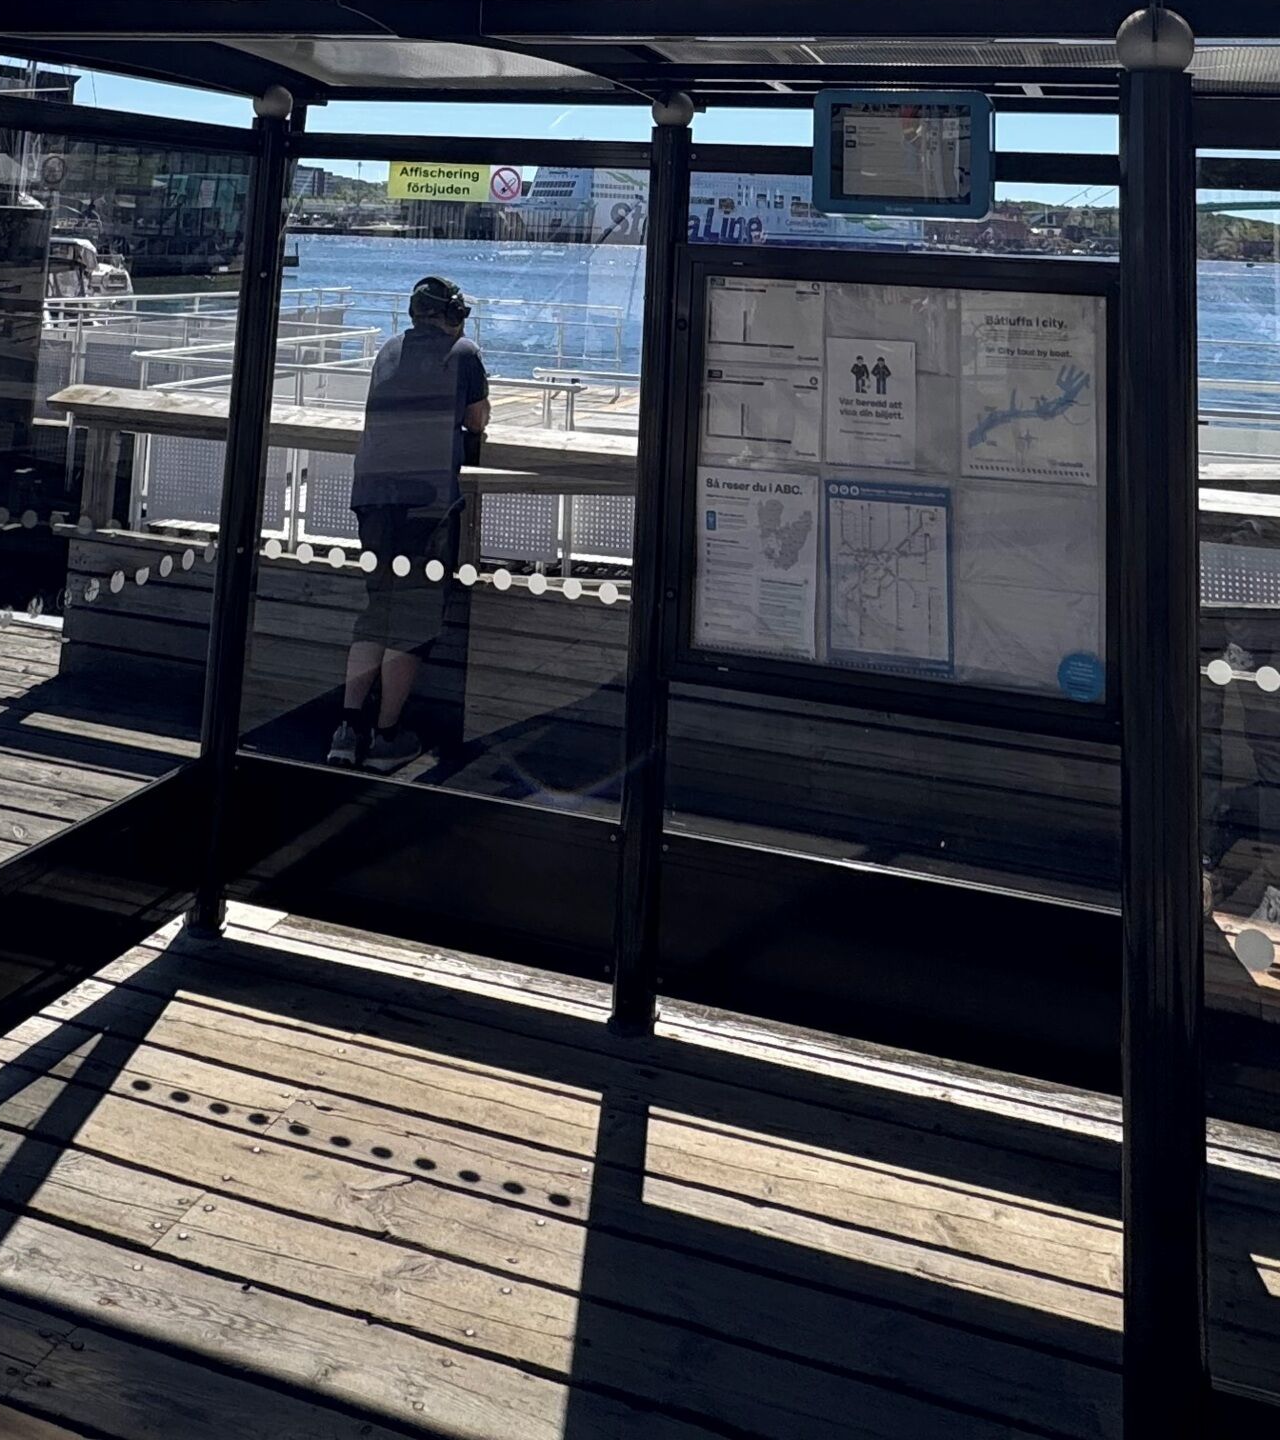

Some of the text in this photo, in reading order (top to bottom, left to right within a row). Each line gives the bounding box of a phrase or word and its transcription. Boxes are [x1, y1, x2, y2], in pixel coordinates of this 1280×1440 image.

[400, 166, 480, 182] Affischering
[407, 182, 470, 196] förbjuden
[1041, 317, 1068, 329] city.
[752, 482, 767, 492] du
[775, 483, 803, 495] ABC.
